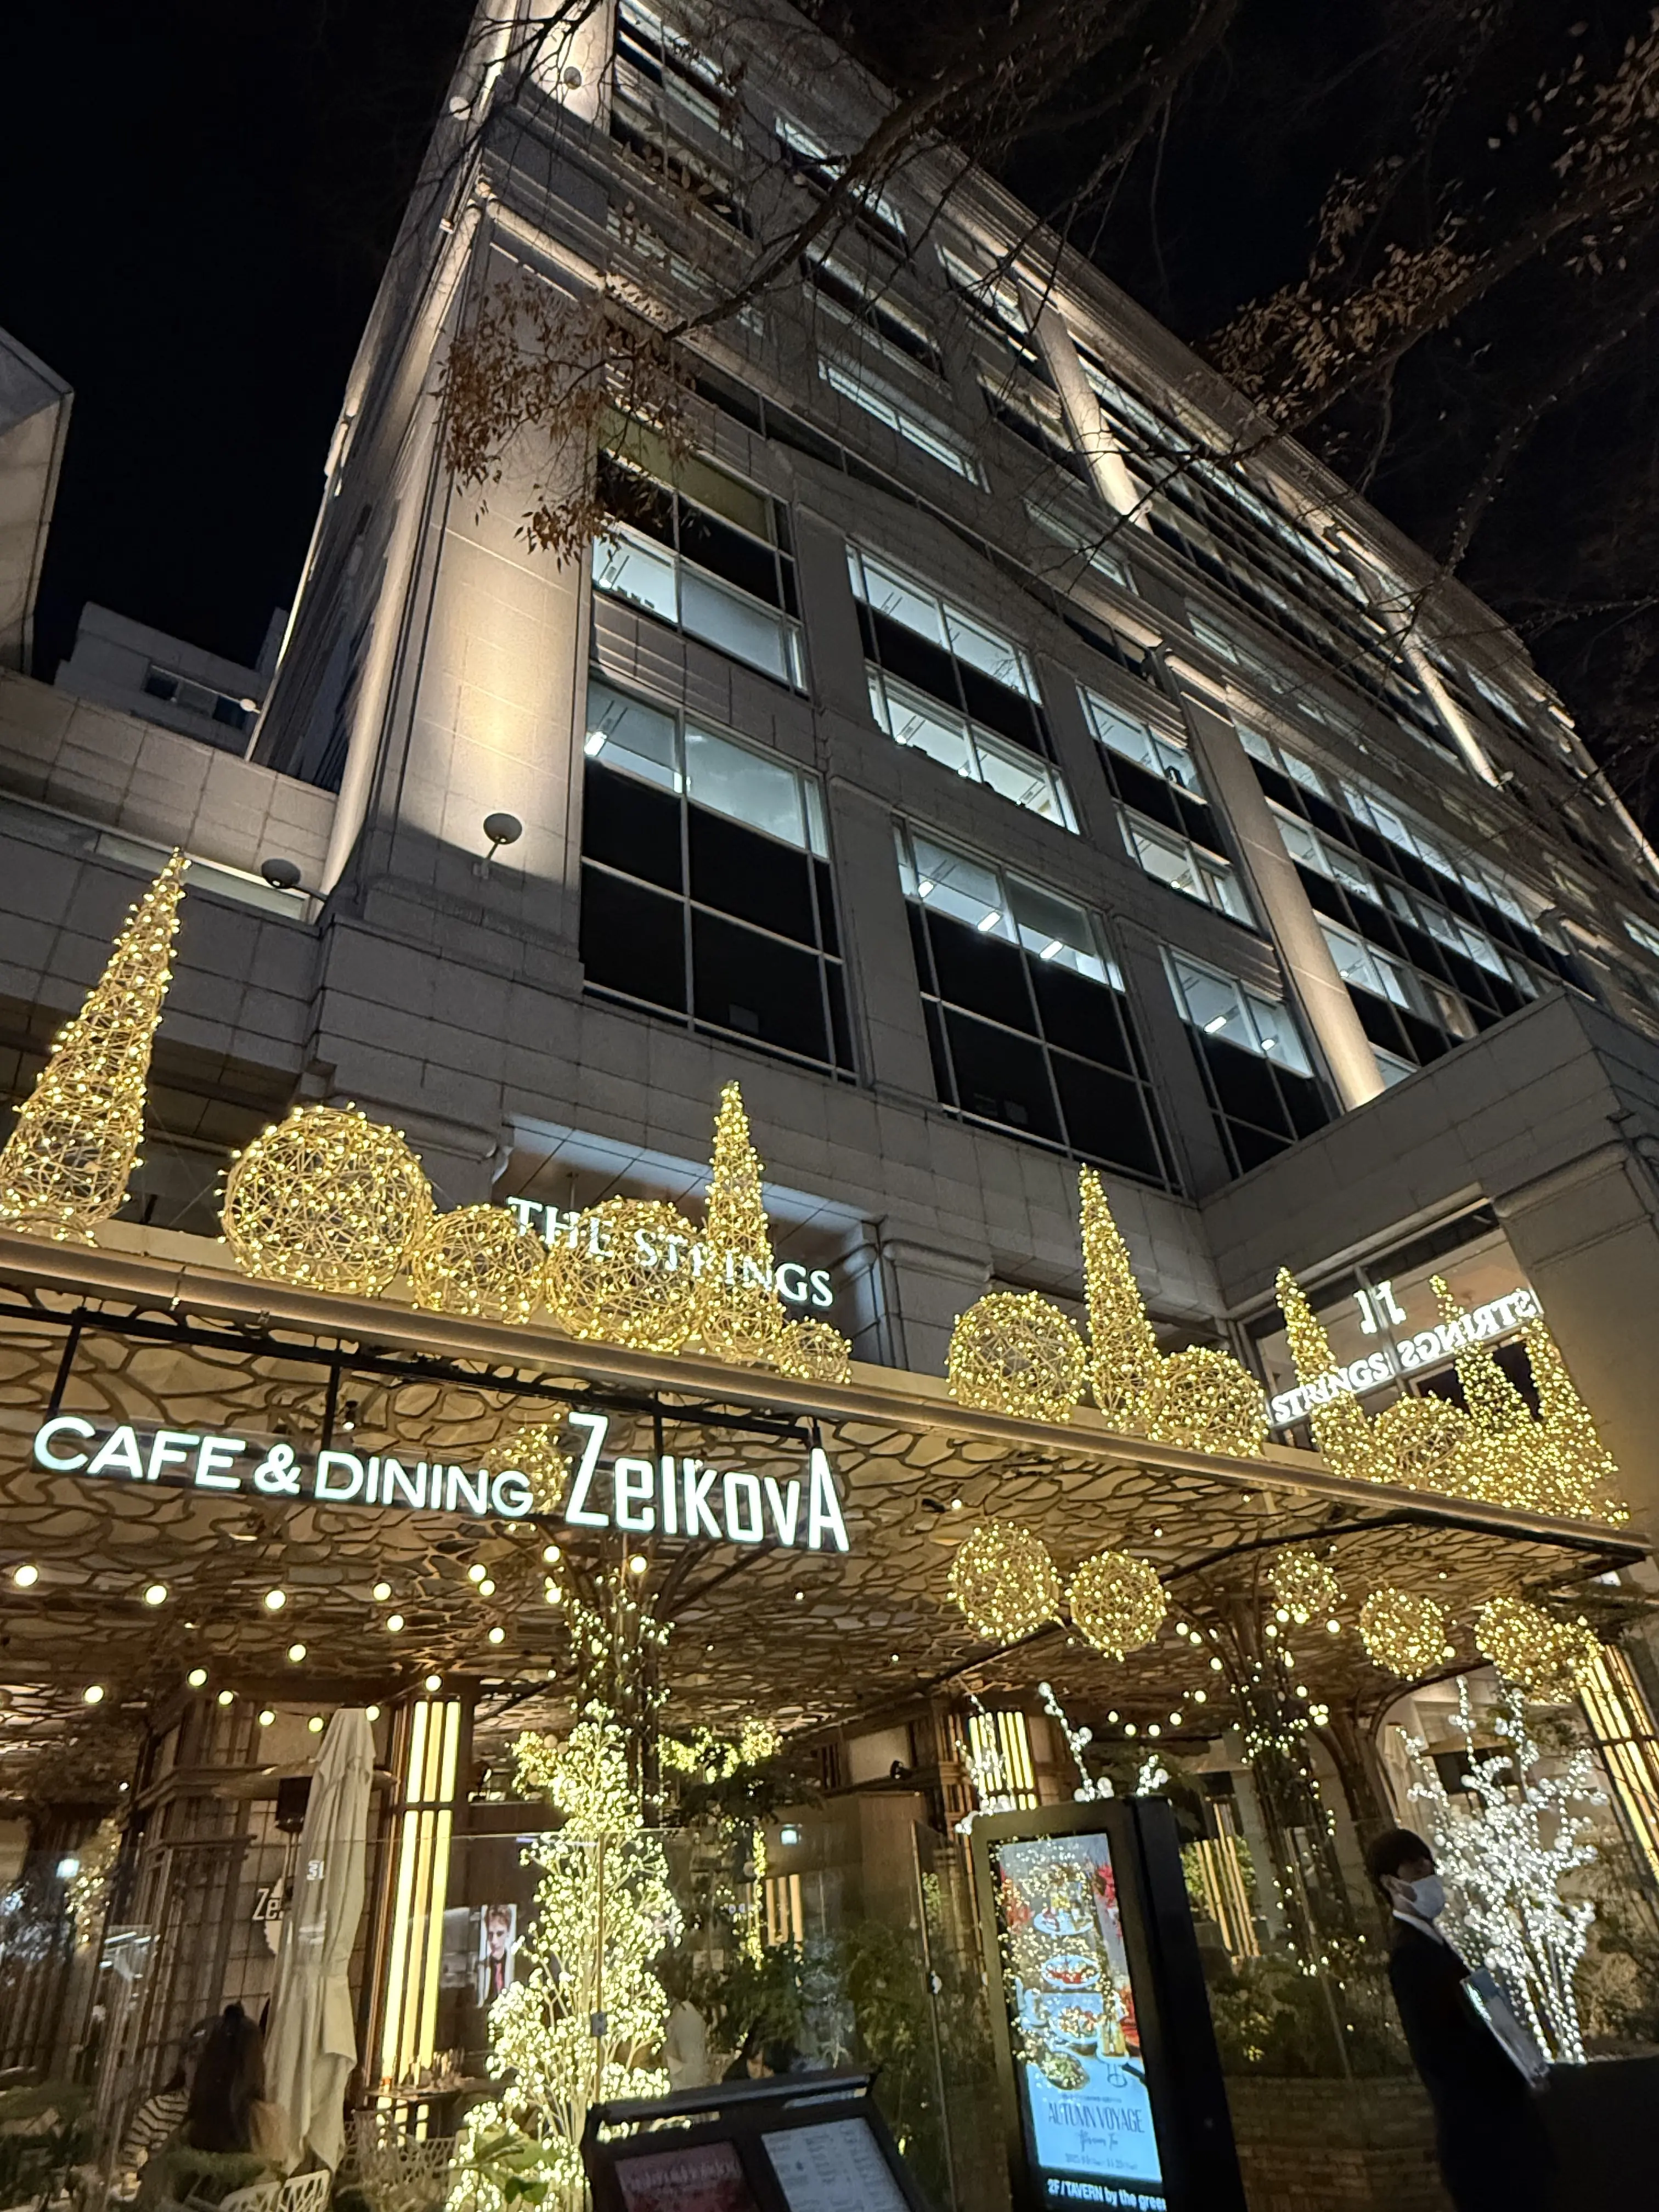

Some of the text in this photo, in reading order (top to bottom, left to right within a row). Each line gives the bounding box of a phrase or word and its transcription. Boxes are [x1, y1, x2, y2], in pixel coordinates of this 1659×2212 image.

[506, 1196, 614, 1257] THE
[34, 1415, 246, 1491] CAFE
[253, 1443, 302, 1495] &
[314, 1450, 533, 1517] DINING
[252, 1888, 284, 1921] Ze
[1096, 2106, 1146, 2133] VOYAGE
[1104, 2186, 1118, 2207] by
[1119, 2189, 1137, 2208] the
